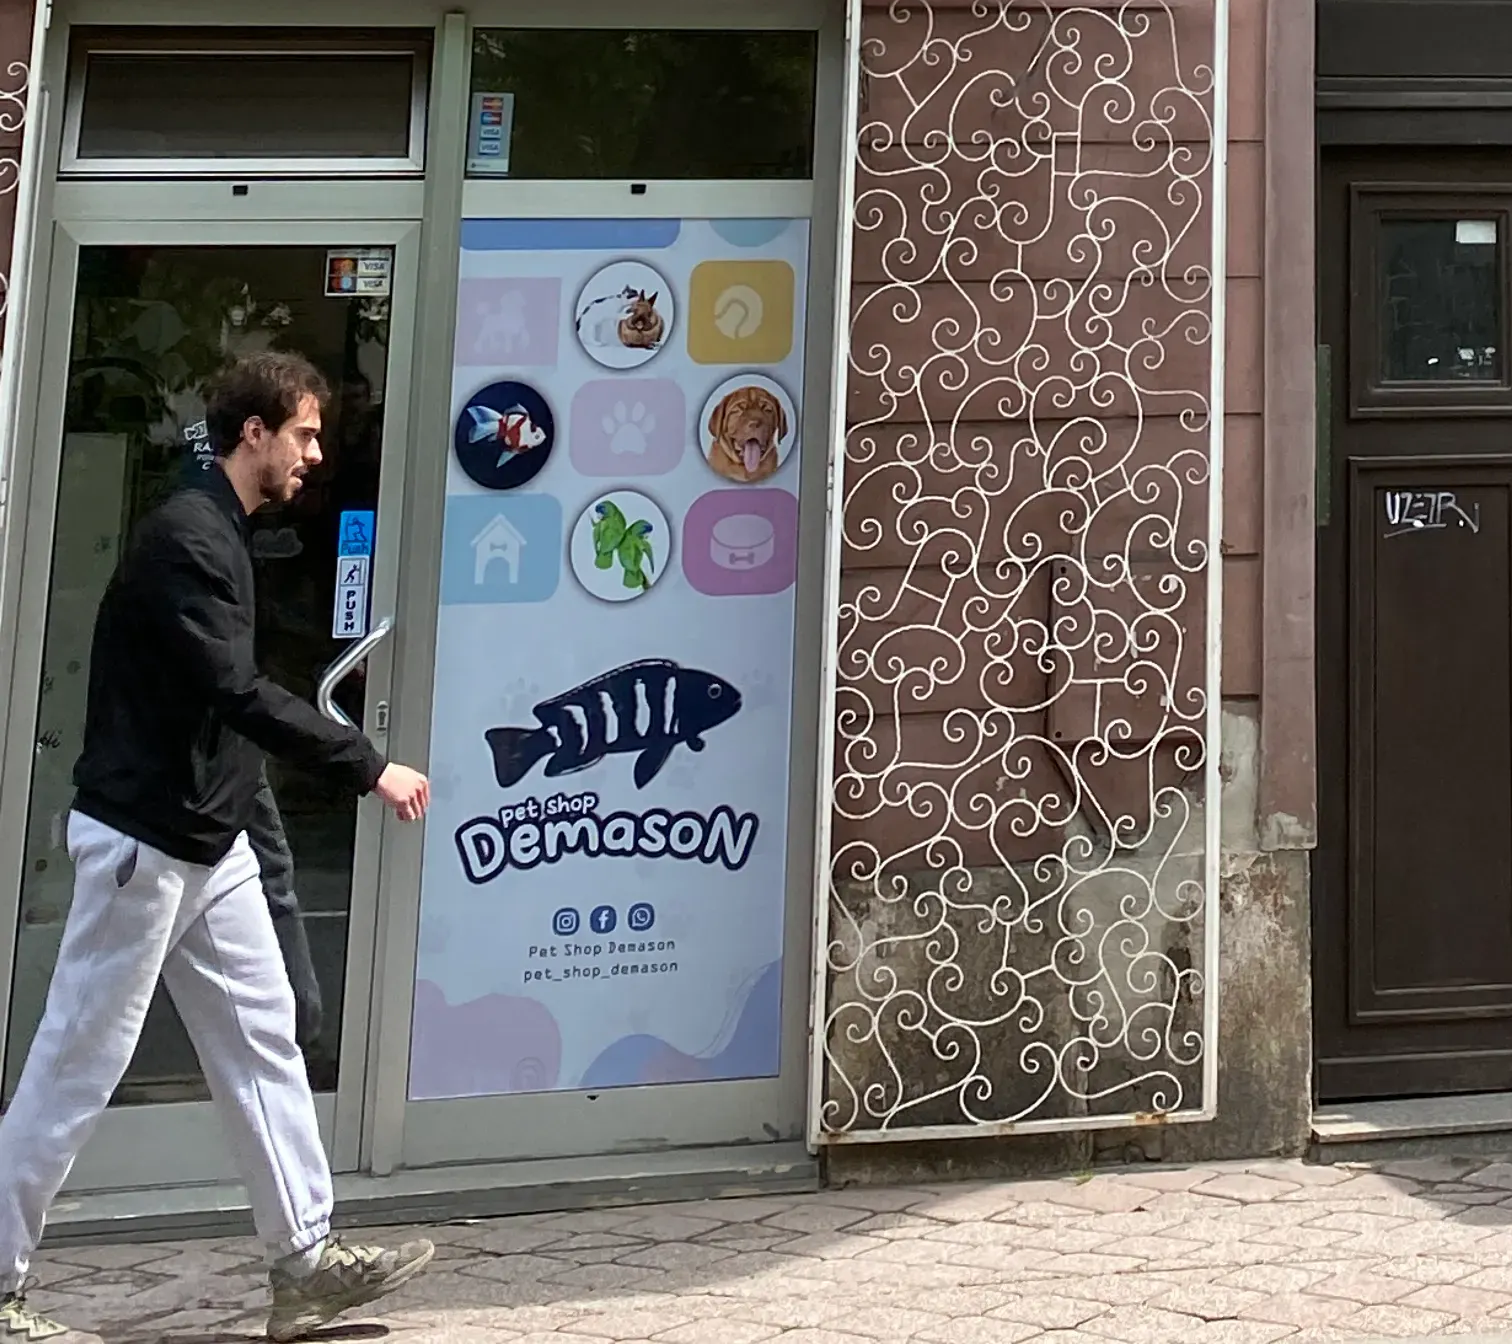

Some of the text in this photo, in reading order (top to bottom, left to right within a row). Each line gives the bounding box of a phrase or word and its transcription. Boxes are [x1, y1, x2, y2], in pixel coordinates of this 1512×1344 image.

[363, 261, 386, 271] VISA
[344, 590, 356, 631] PUSH
[546, 792, 596, 815] shop
[529, 938, 676, 959] Pet Shop Demason
[523, 961, 678, 983] pet_shop_demason
